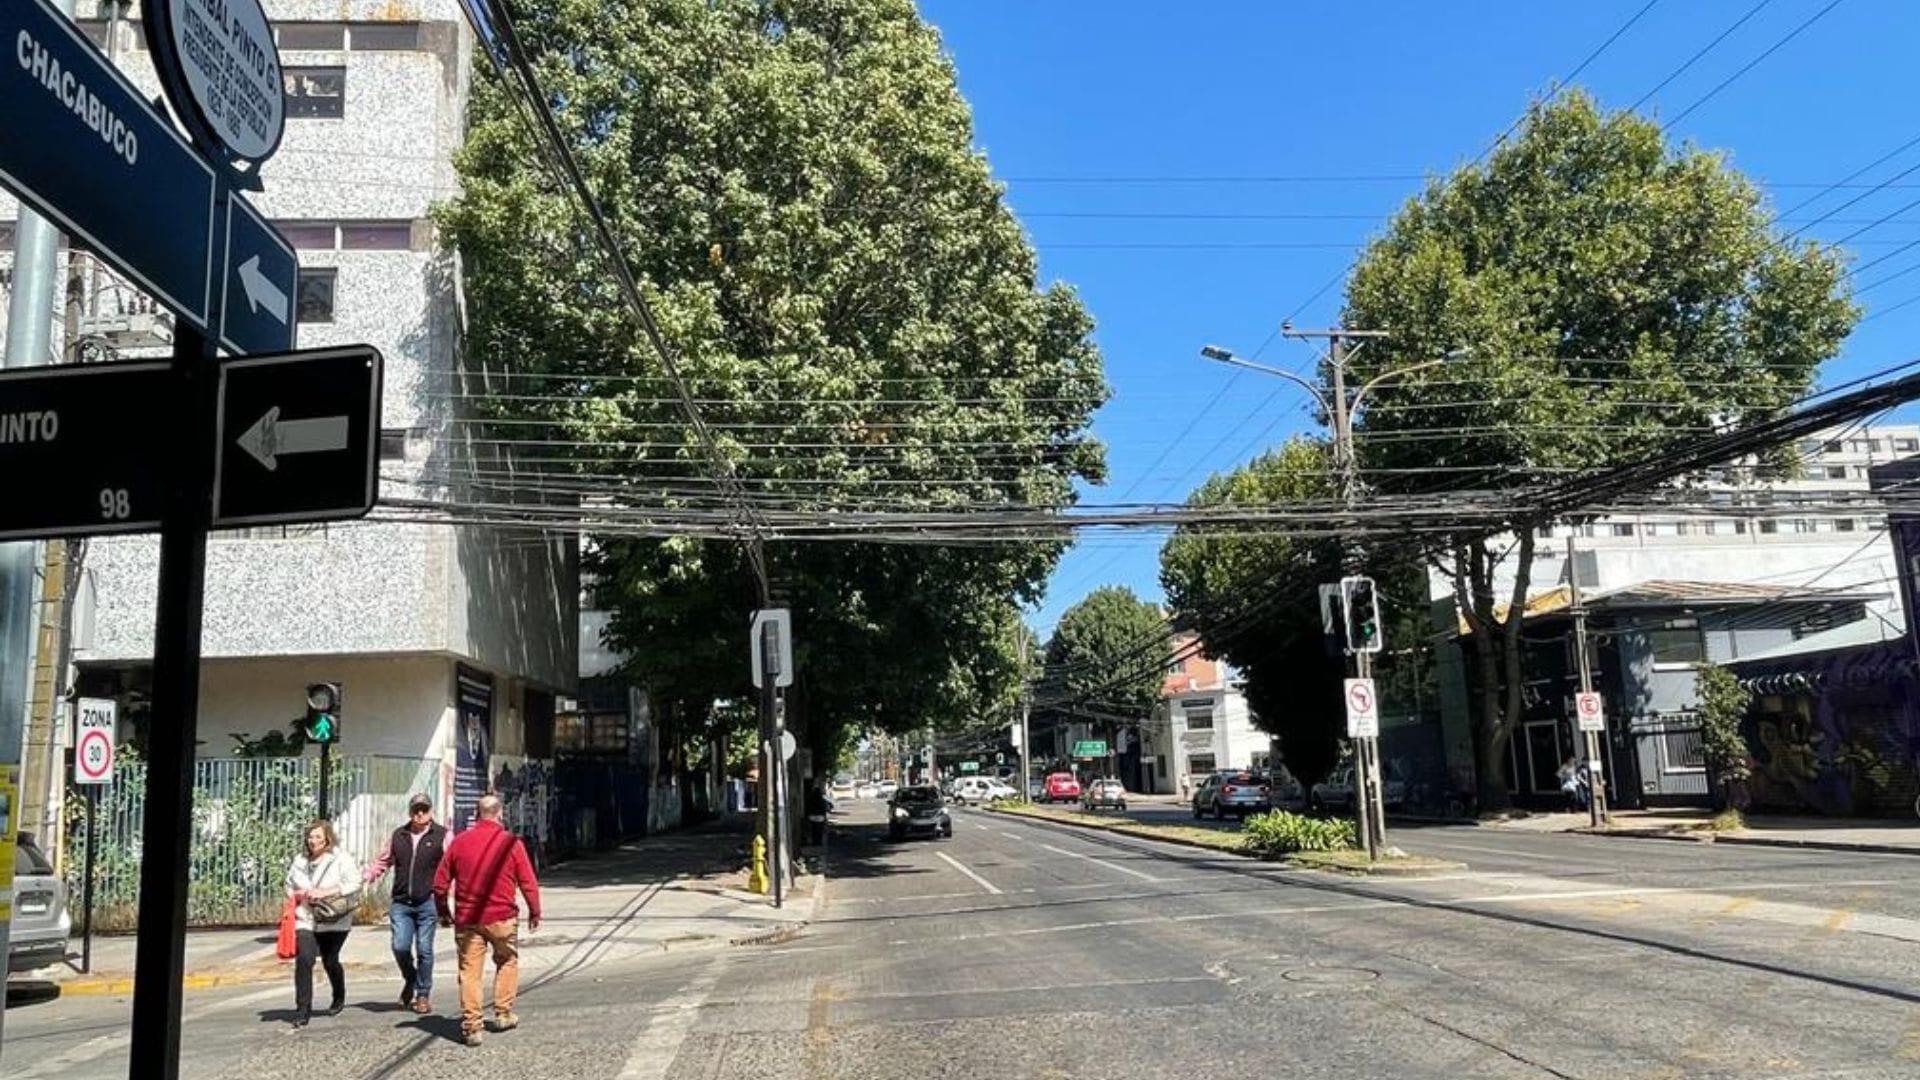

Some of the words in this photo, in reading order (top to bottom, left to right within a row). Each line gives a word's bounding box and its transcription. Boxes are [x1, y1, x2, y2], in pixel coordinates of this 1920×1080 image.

[232, 16, 265, 77] PINTO
[183, 27, 220, 89] PRESIDENTE
[220, 72, 229, 100] DE
[229, 82, 238, 108] LA
[224, 52, 234, 79] DE
[17, 29, 138, 165] CHACABUCO
[0, 410, 58, 442] INTO
[100, 488, 130, 518] 98
[82, 708, 112, 728] ZONA
[89, 745, 101, 762] 30
